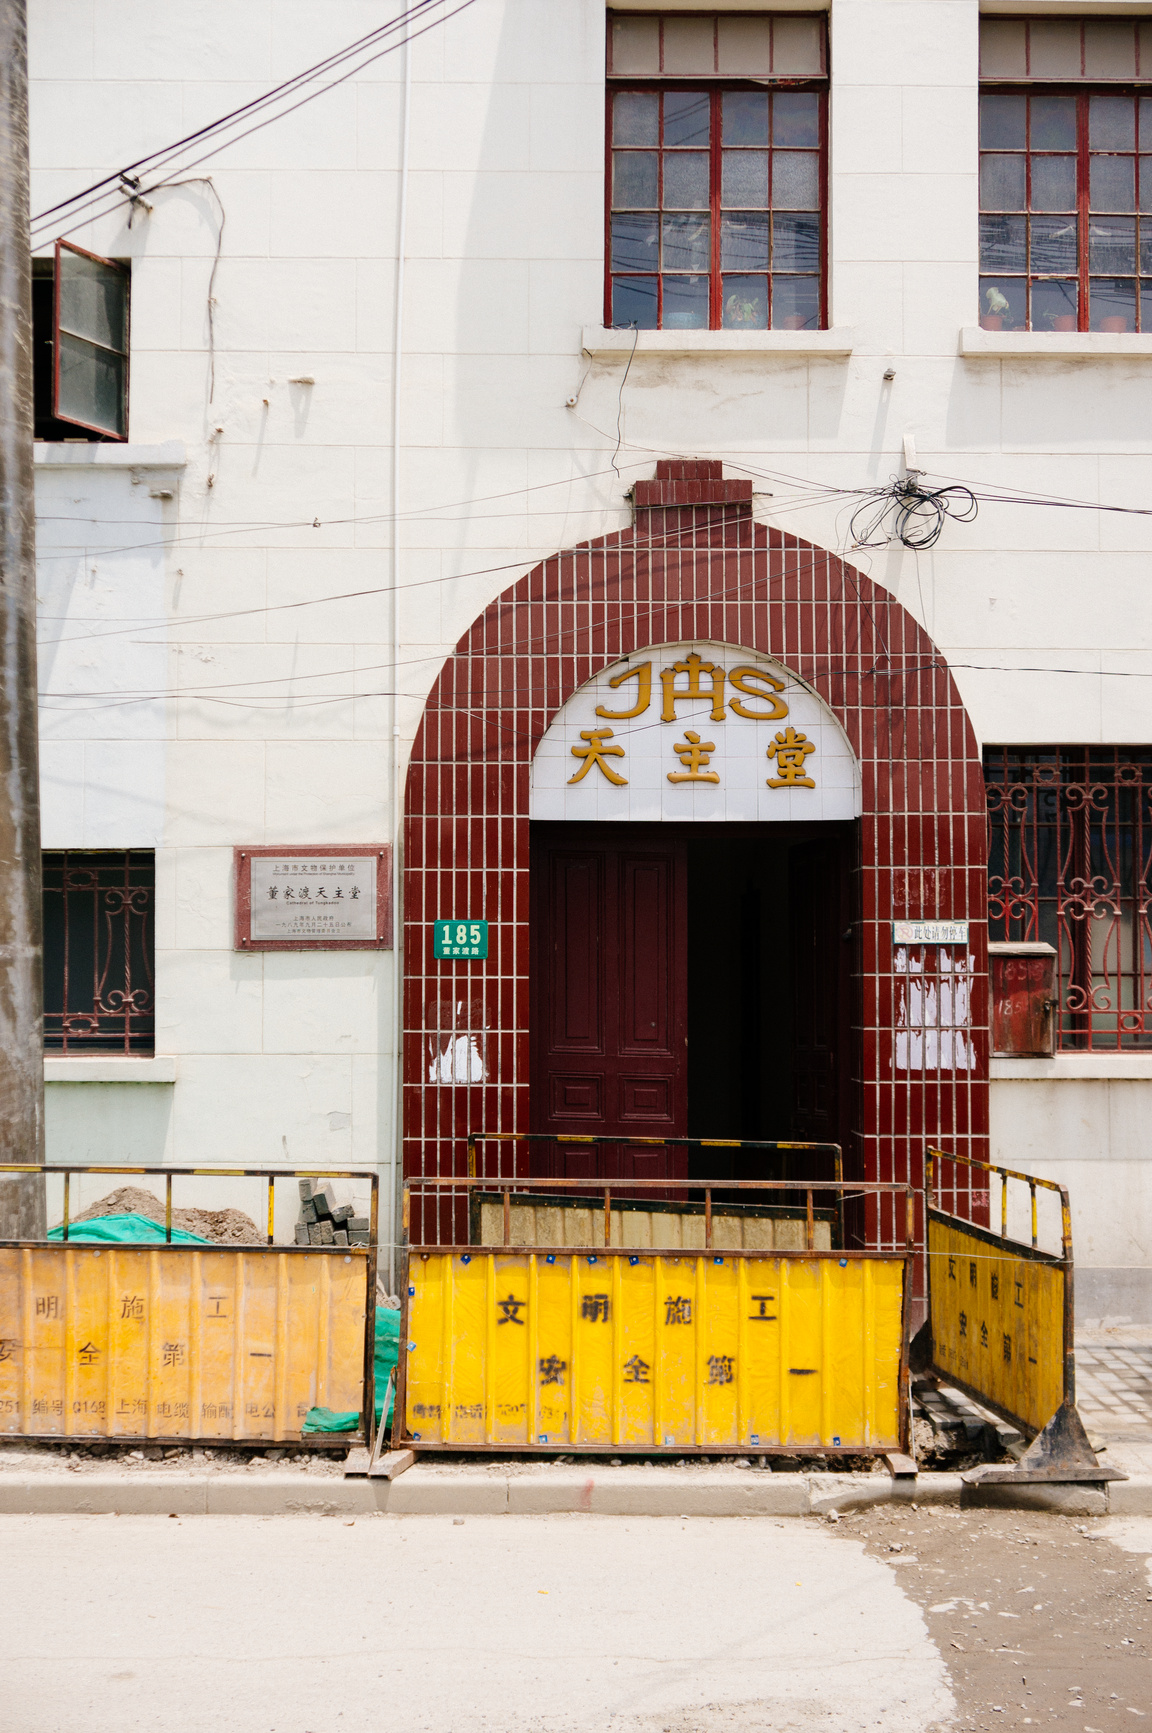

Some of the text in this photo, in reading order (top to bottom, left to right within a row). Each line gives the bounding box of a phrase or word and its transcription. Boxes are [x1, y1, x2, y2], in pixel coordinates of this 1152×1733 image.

[567, 727, 817, 789] 天主堂
[273, 864, 355, 872] 上海市文物保护单位
[266, 885, 361, 900] 董家渡天主堂
[441, 924, 481, 945] 185
[914, 925, 966, 941] 此处请勿停车
[442, 946, 480, 955] 董家渡路
[949, 1255, 1024, 1309] 文明施工
[496, 1293, 778, 1326] 文明施工
[959, 1310, 1038, 1364] 安全第一
[538, 1354, 818, 1386] 安全第一
